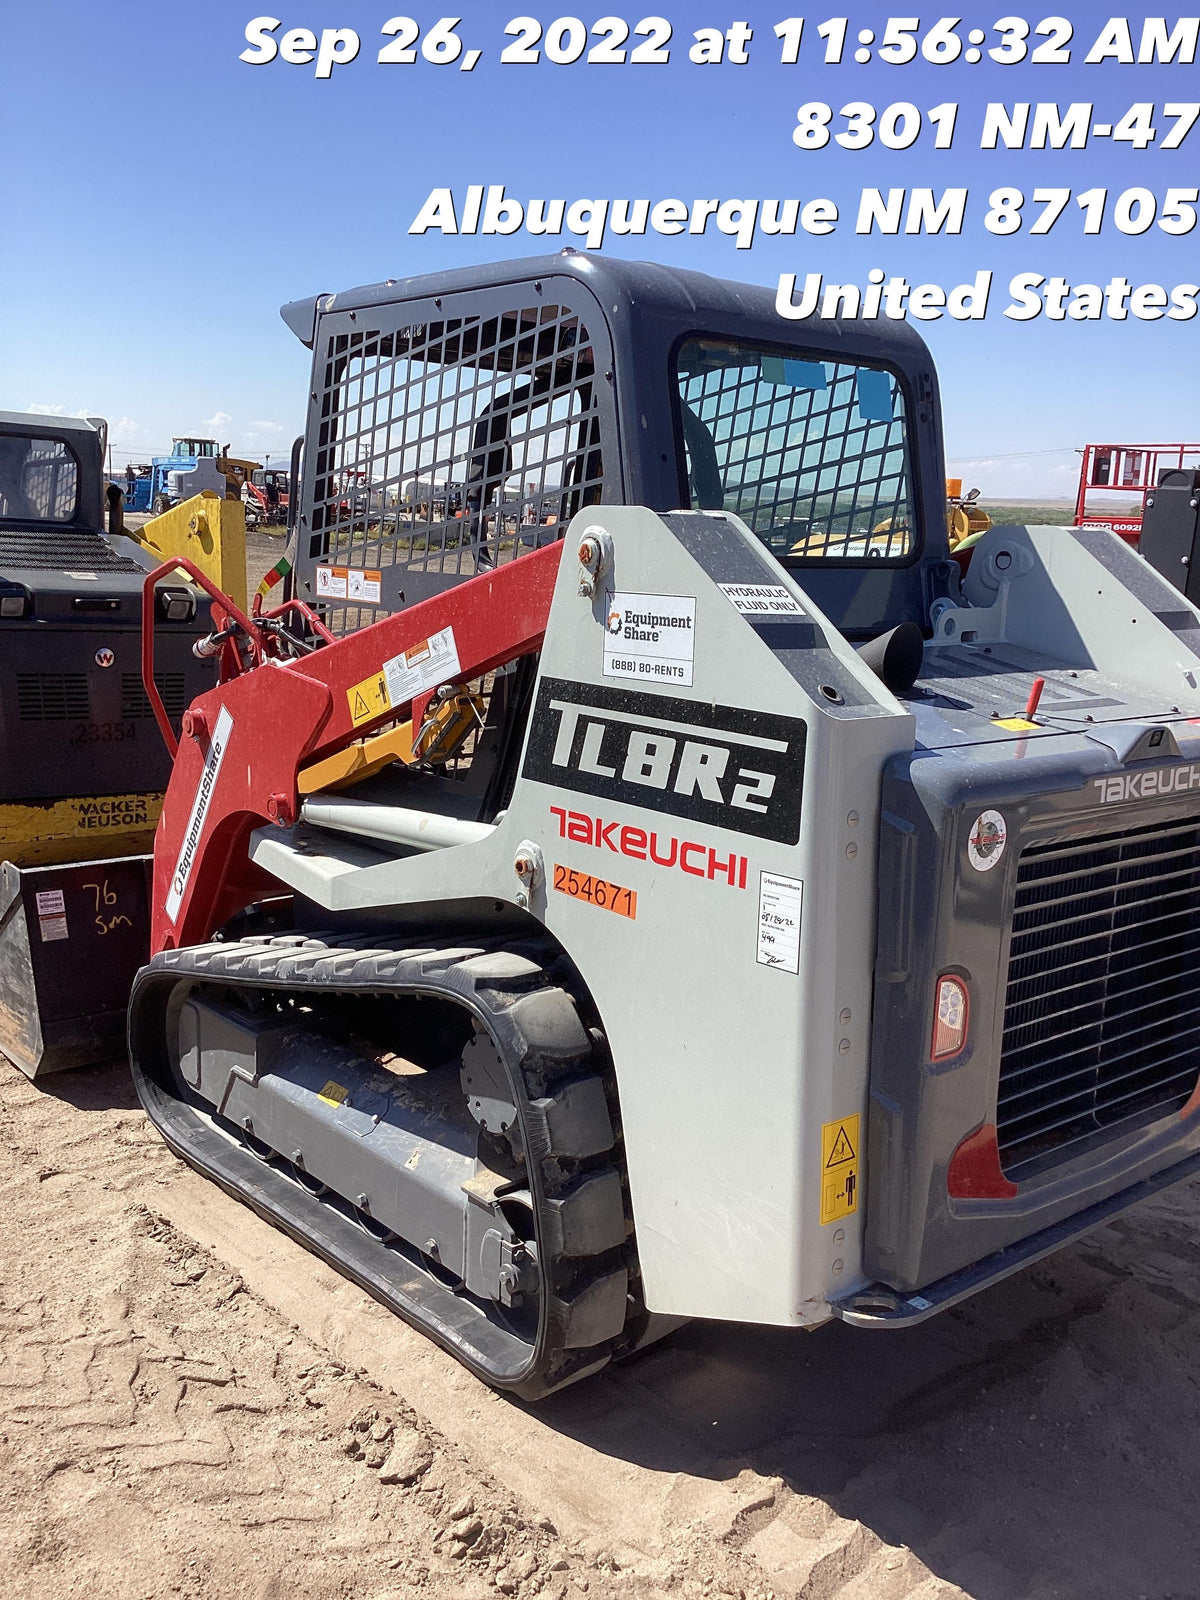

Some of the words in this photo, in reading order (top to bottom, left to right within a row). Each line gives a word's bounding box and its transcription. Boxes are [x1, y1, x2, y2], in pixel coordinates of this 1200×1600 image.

[722, 586, 789, 599] HYDRAULIC
[735, 600, 769, 611] FLUID
[769, 601, 799, 612] ONLY
[624, 610, 692, 629] Equipment
[624, 626, 660, 642] Share
[612, 658, 636, 672] (888)
[639, 662, 684, 678] 80-RENTS
[1094, 765, 1200, 804] TAKEUCH
[178, 740, 222, 881] EquipmentShare
[82, 879, 117, 912] 76
[555, 865, 635, 917] 254671
